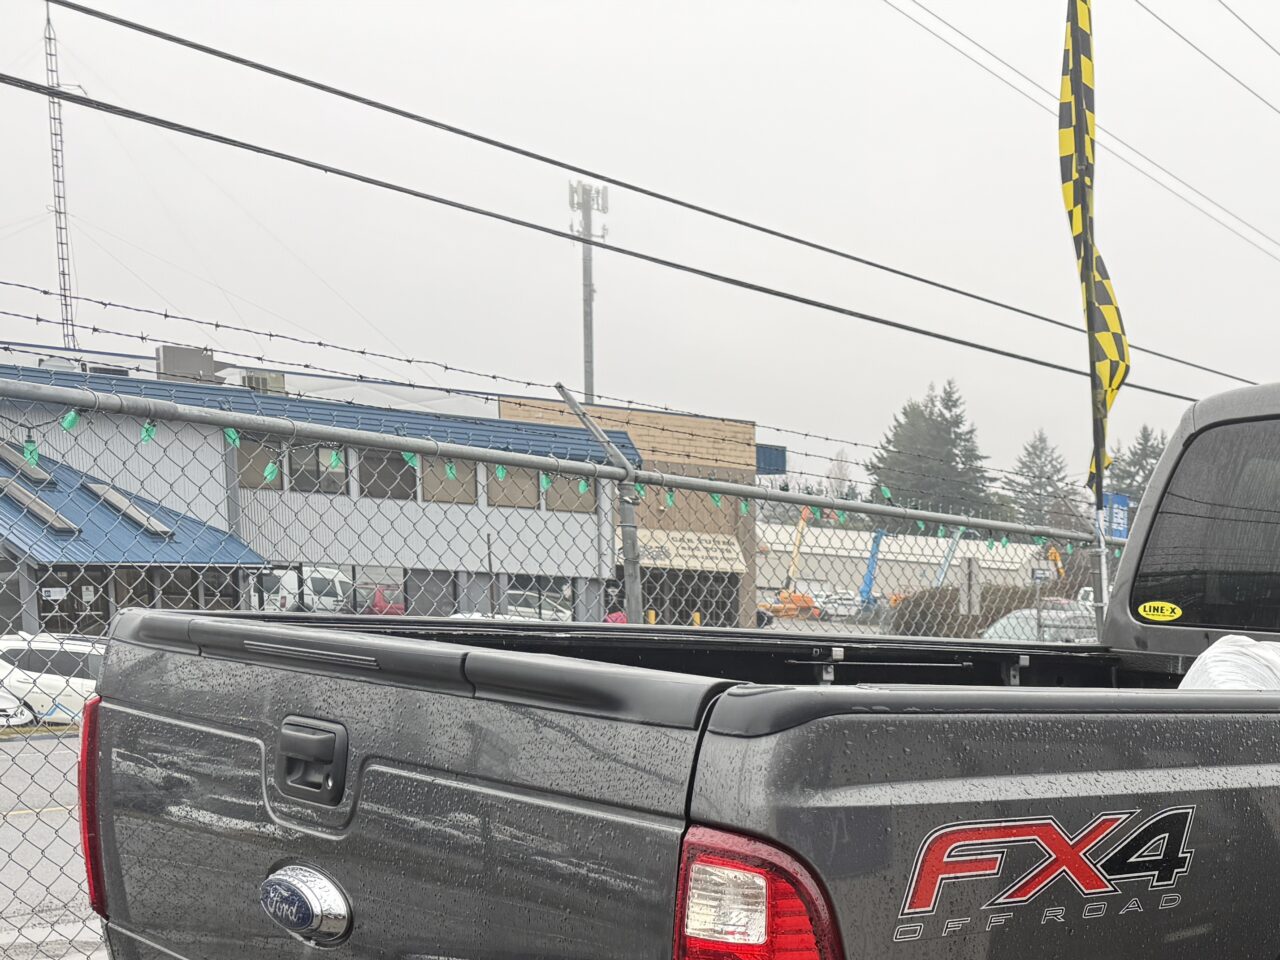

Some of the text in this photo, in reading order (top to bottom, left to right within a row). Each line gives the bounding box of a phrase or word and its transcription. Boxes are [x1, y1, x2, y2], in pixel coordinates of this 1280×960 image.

[898, 804, 1197, 918] FX4
[266, 884, 303, 922] Ford
[893, 893, 1182, 942] OFF ROAD
